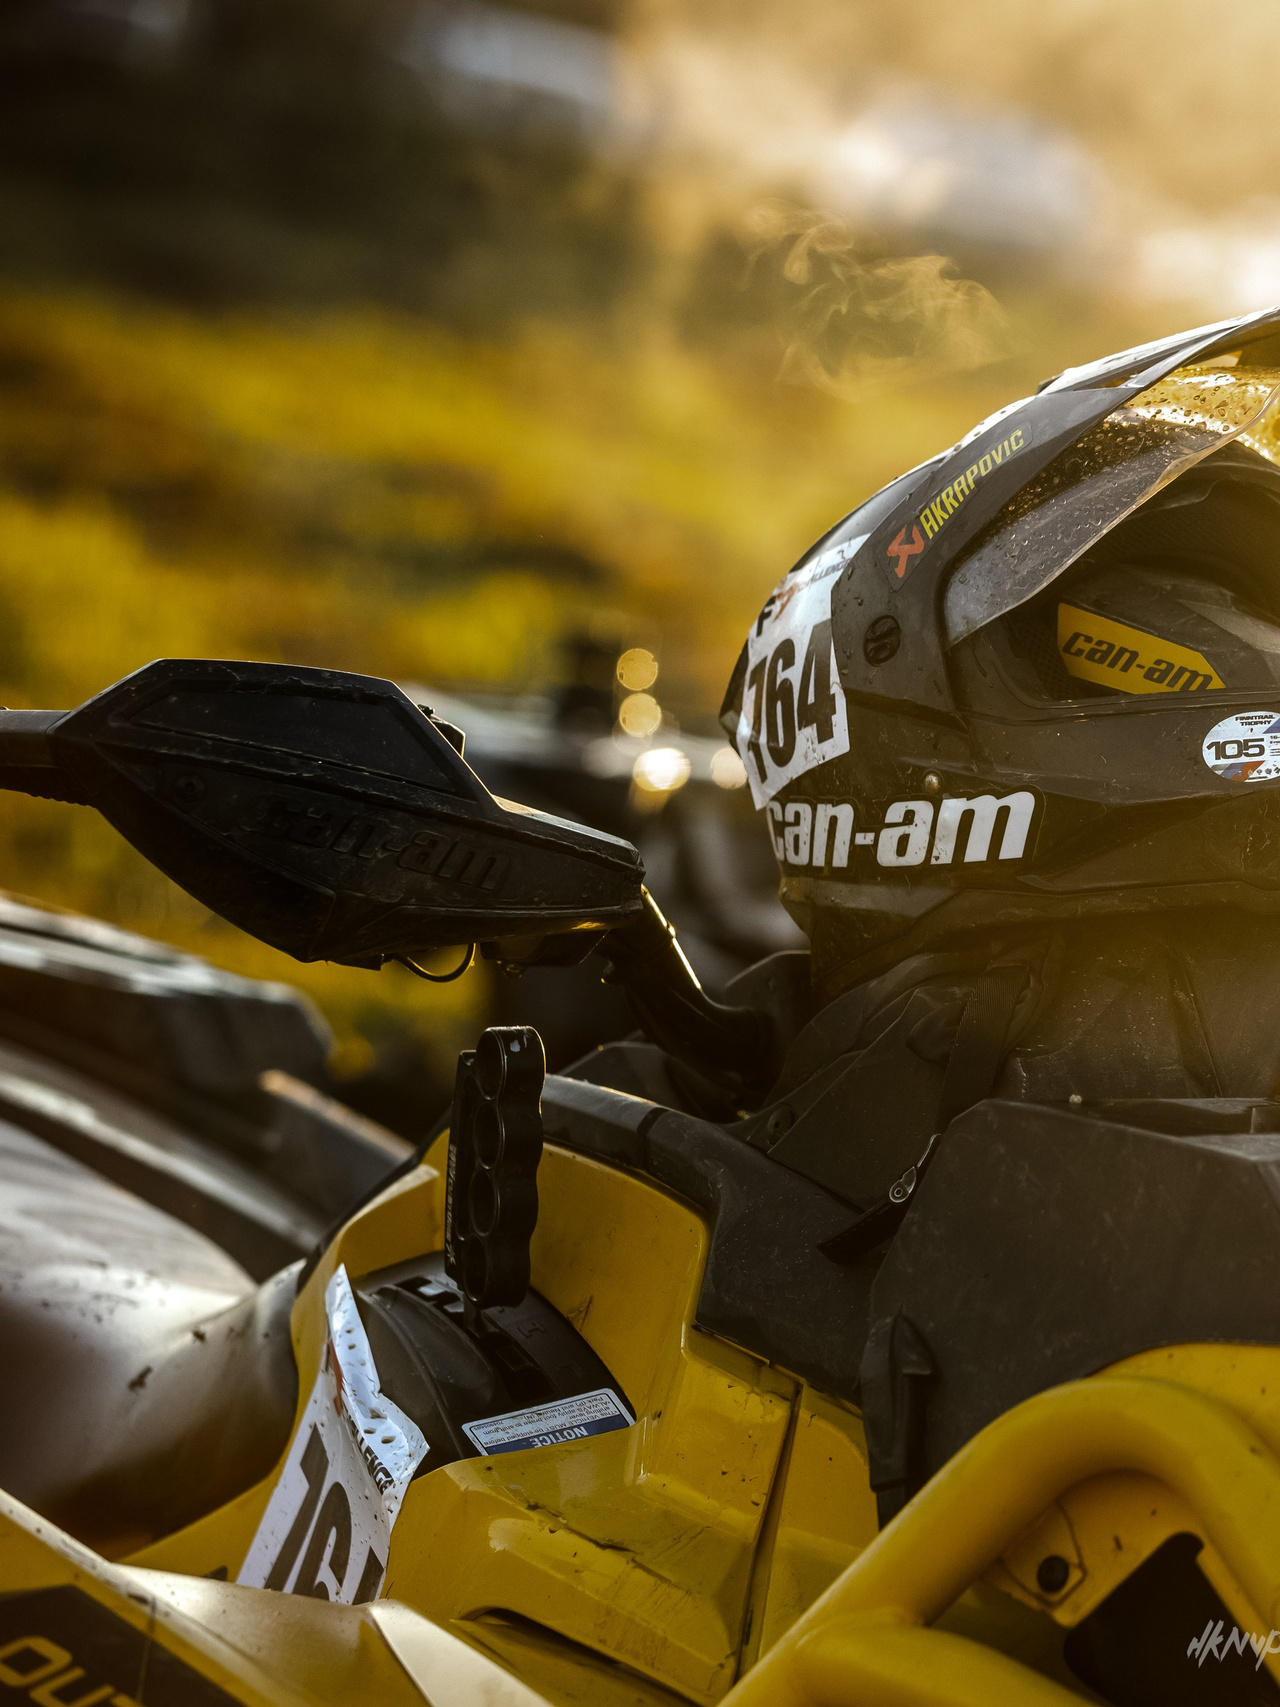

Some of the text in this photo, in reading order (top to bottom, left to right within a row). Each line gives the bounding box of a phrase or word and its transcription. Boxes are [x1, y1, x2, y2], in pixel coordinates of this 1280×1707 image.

[1062, 631, 1214, 692] can-am
[748, 618, 837, 785] 764
[1206, 738, 1266, 761] 105
[766, 791, 1036, 868] can-am
[556, 1408, 576, 1416] apply
[575, 1400, 608, 1411] ALWAYS
[545, 1422, 567, 1431] MUST
[566, 1414, 600, 1425] VEHICLE
[483, 1437, 506, 1446] before
[530, 1426, 589, 1448] NOTICE
[0, 1635, 150, 1707] OU
